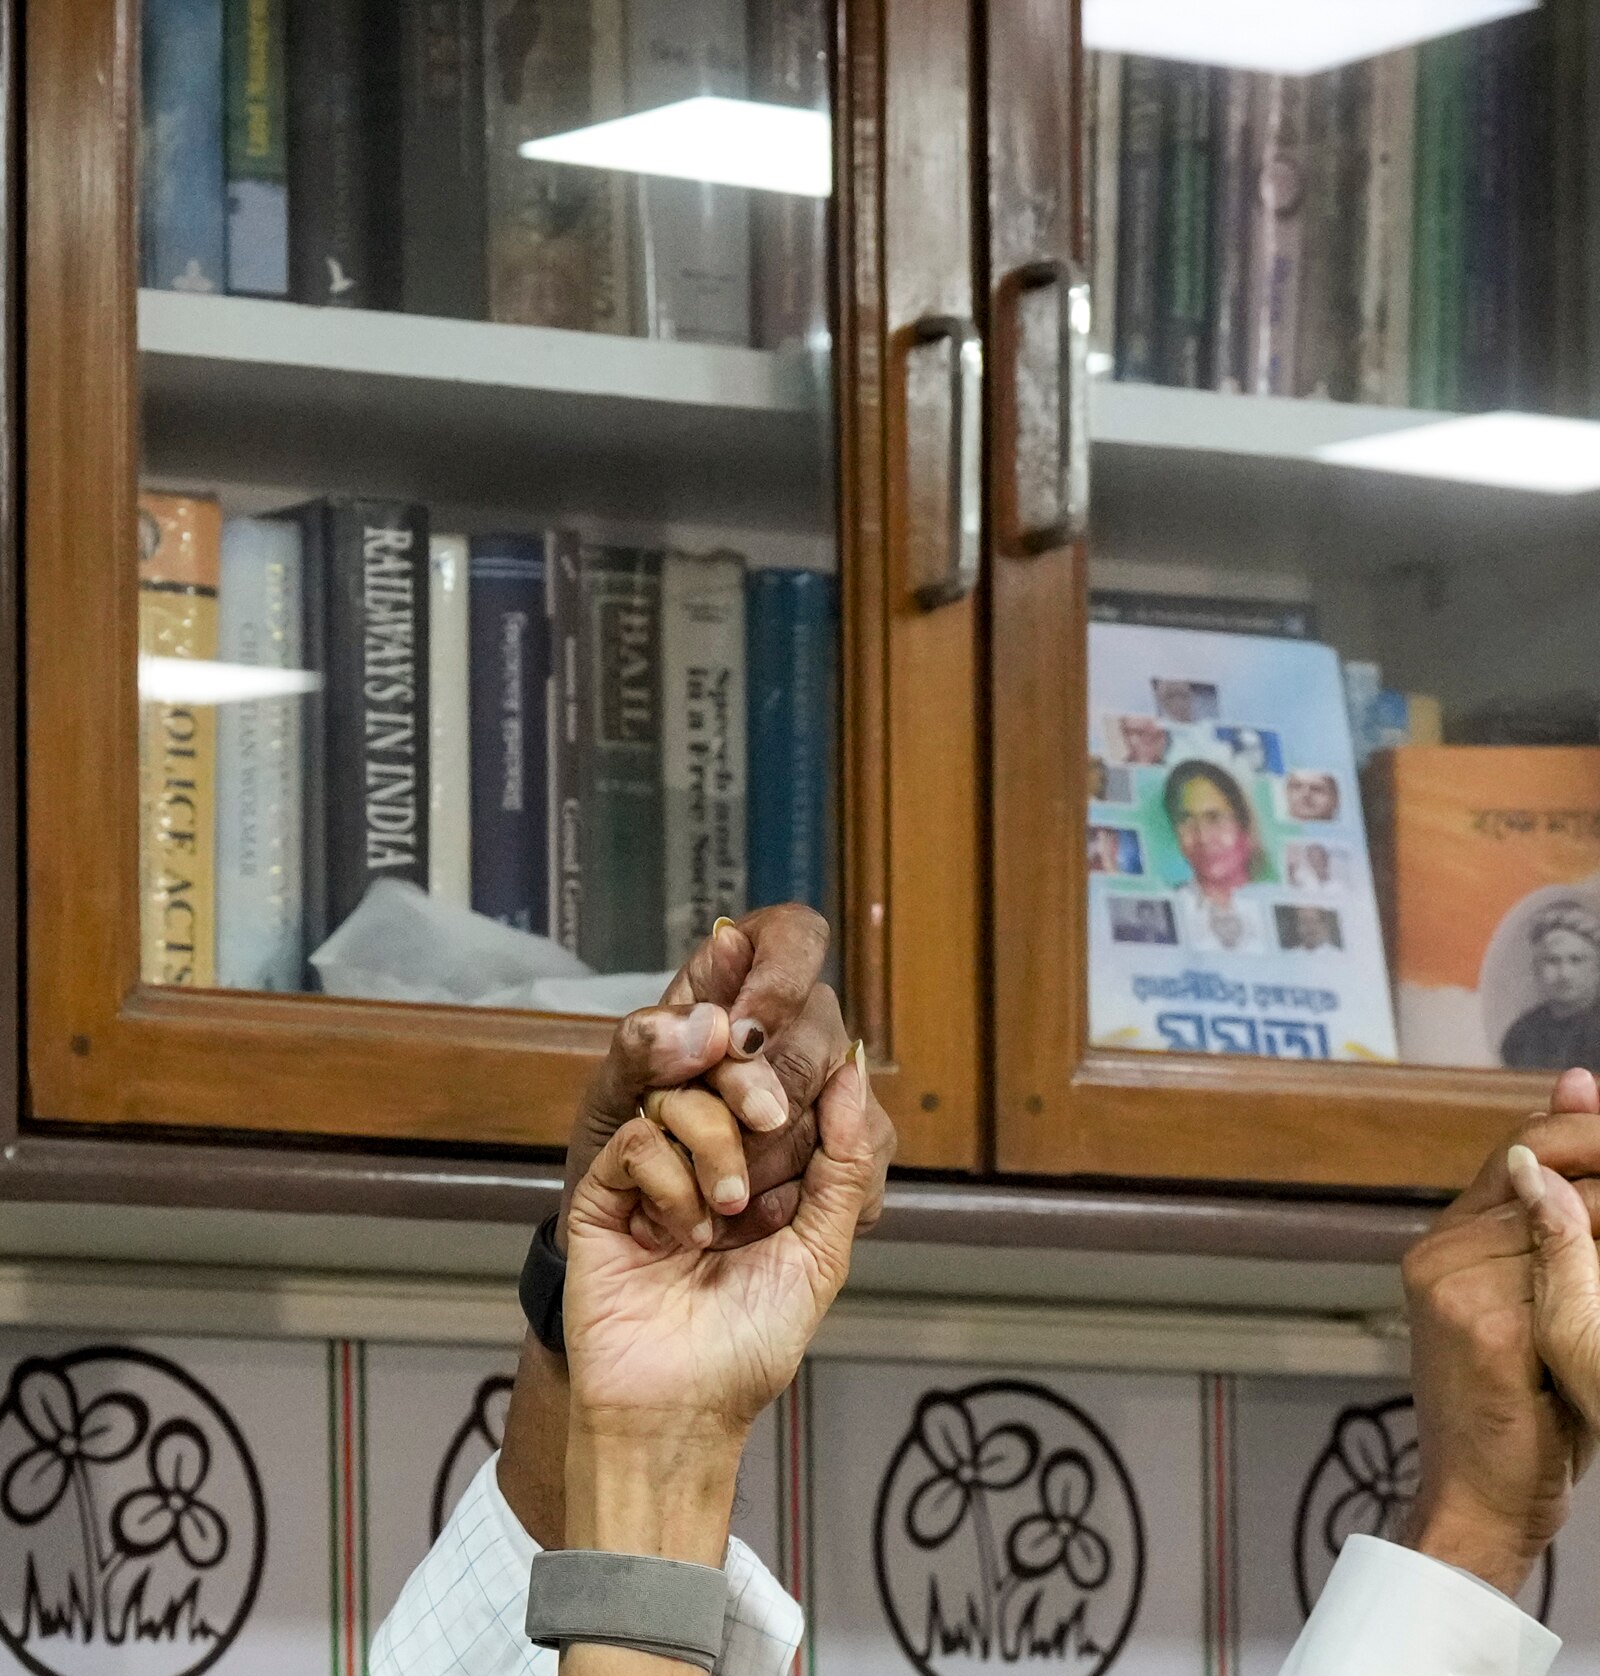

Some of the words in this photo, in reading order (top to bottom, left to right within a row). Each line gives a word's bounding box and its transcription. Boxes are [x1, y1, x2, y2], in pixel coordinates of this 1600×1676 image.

[364, 526, 414, 702] RAILWAYS
[162, 702, 196, 852] OLICE
[366, 709, 414, 754] IN
[366, 761, 416, 869] INDIA
